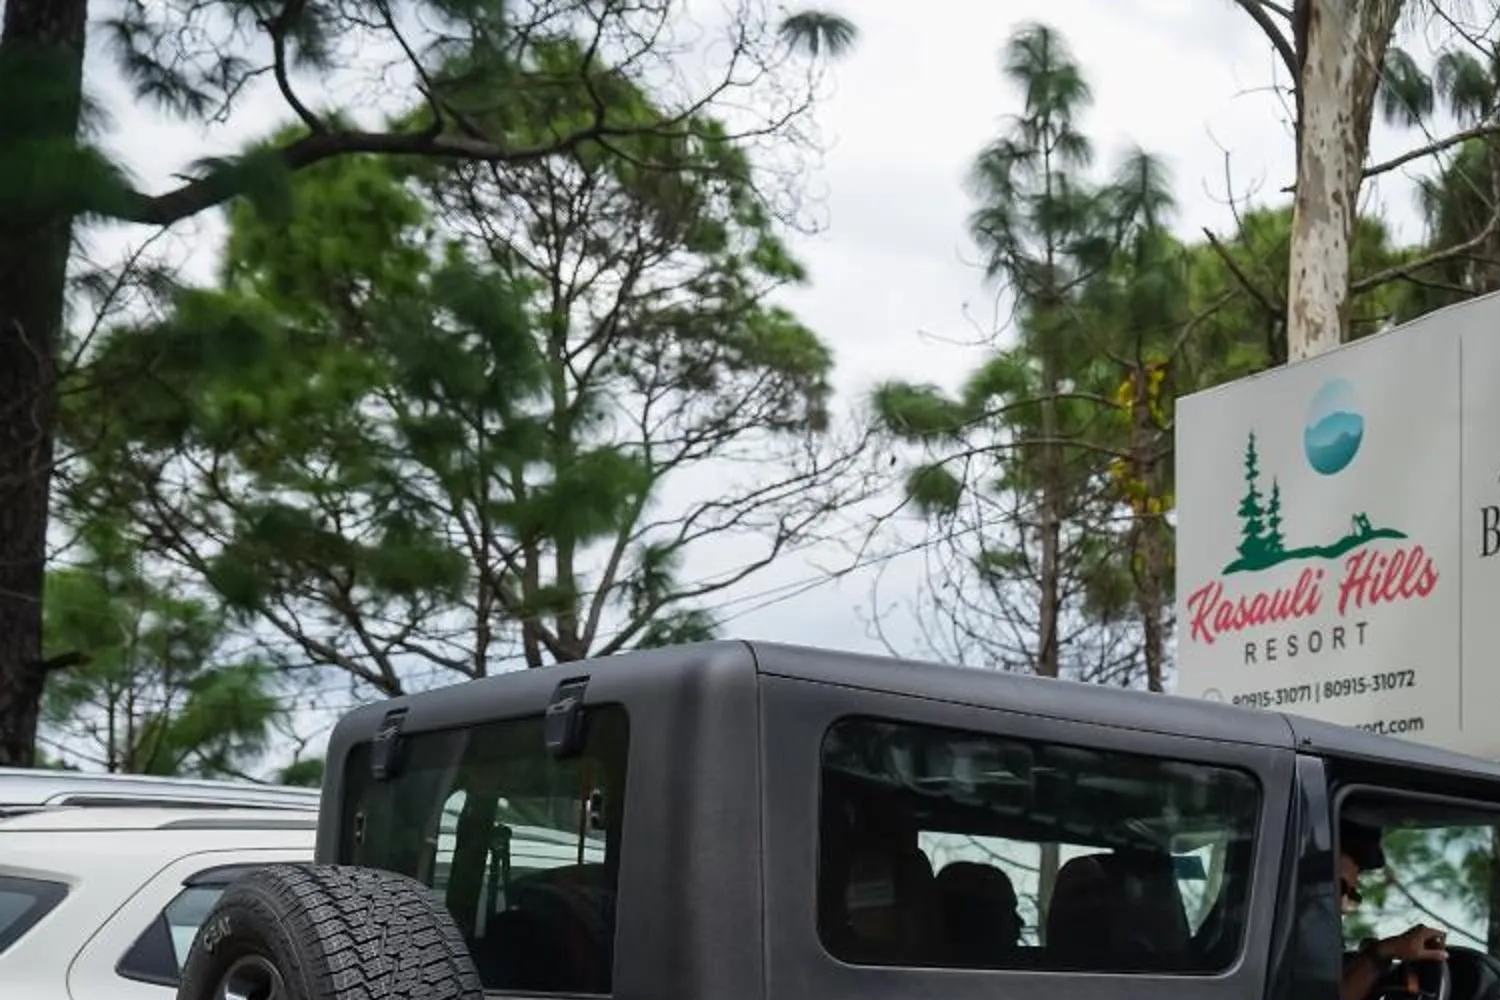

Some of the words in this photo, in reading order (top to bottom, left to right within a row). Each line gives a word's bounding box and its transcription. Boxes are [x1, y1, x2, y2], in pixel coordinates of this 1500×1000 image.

[1187, 568, 1324, 645] Kasauli
[1338, 545, 1440, 617] Hills
[1245, 621, 1368, 665] RESORT
[1323, 669, 1416, 699] 80915-31072
